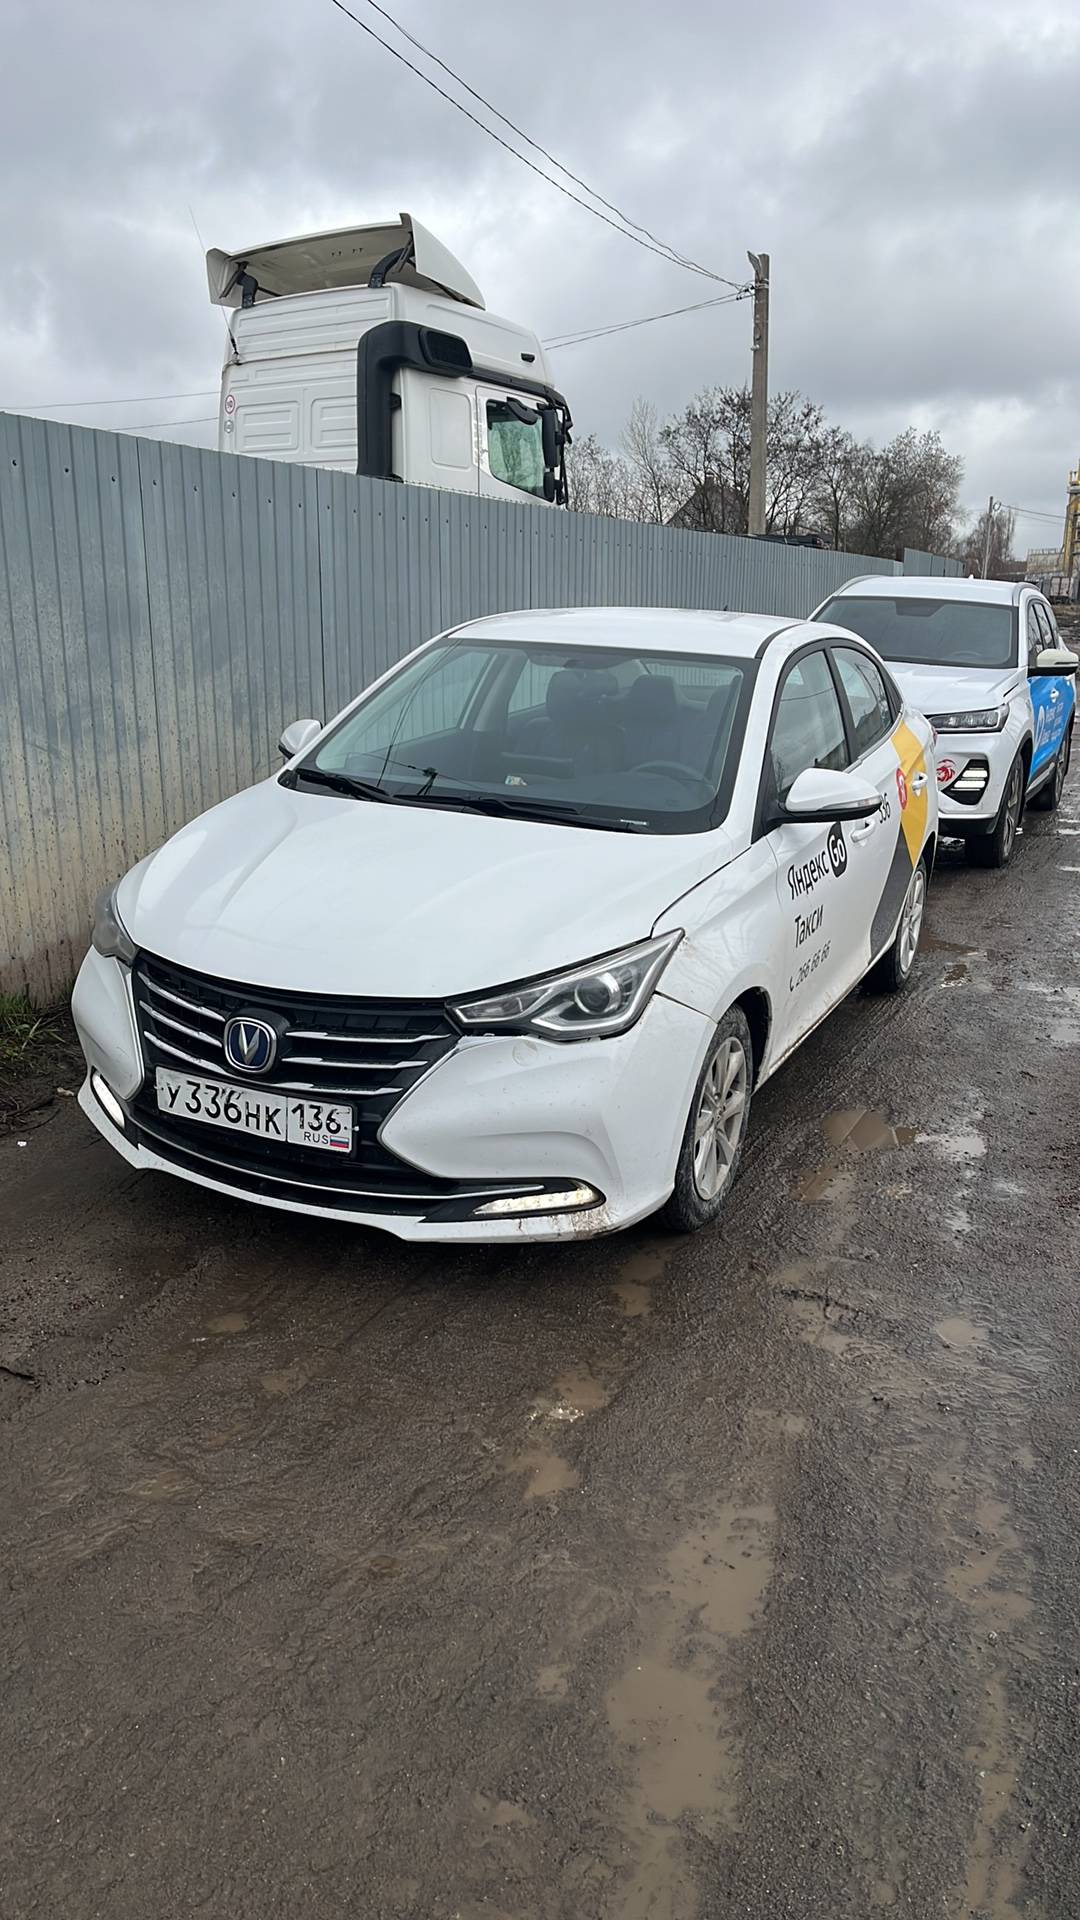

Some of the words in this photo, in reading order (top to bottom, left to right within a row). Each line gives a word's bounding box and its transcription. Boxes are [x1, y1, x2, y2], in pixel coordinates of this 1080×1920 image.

[787, 850, 829, 900] Яндекс
[829, 834, 845, 867] Go
[794, 904, 823, 948] Такси
[795, 958, 812, 987] 266
[810, 949, 821, 972] 66
[820, 940, 831, 963] 66
[166, 1080, 281, 1135] У336НК
[291, 1103, 341, 1134] 136
[303, 1131, 329, 1145] RUS
